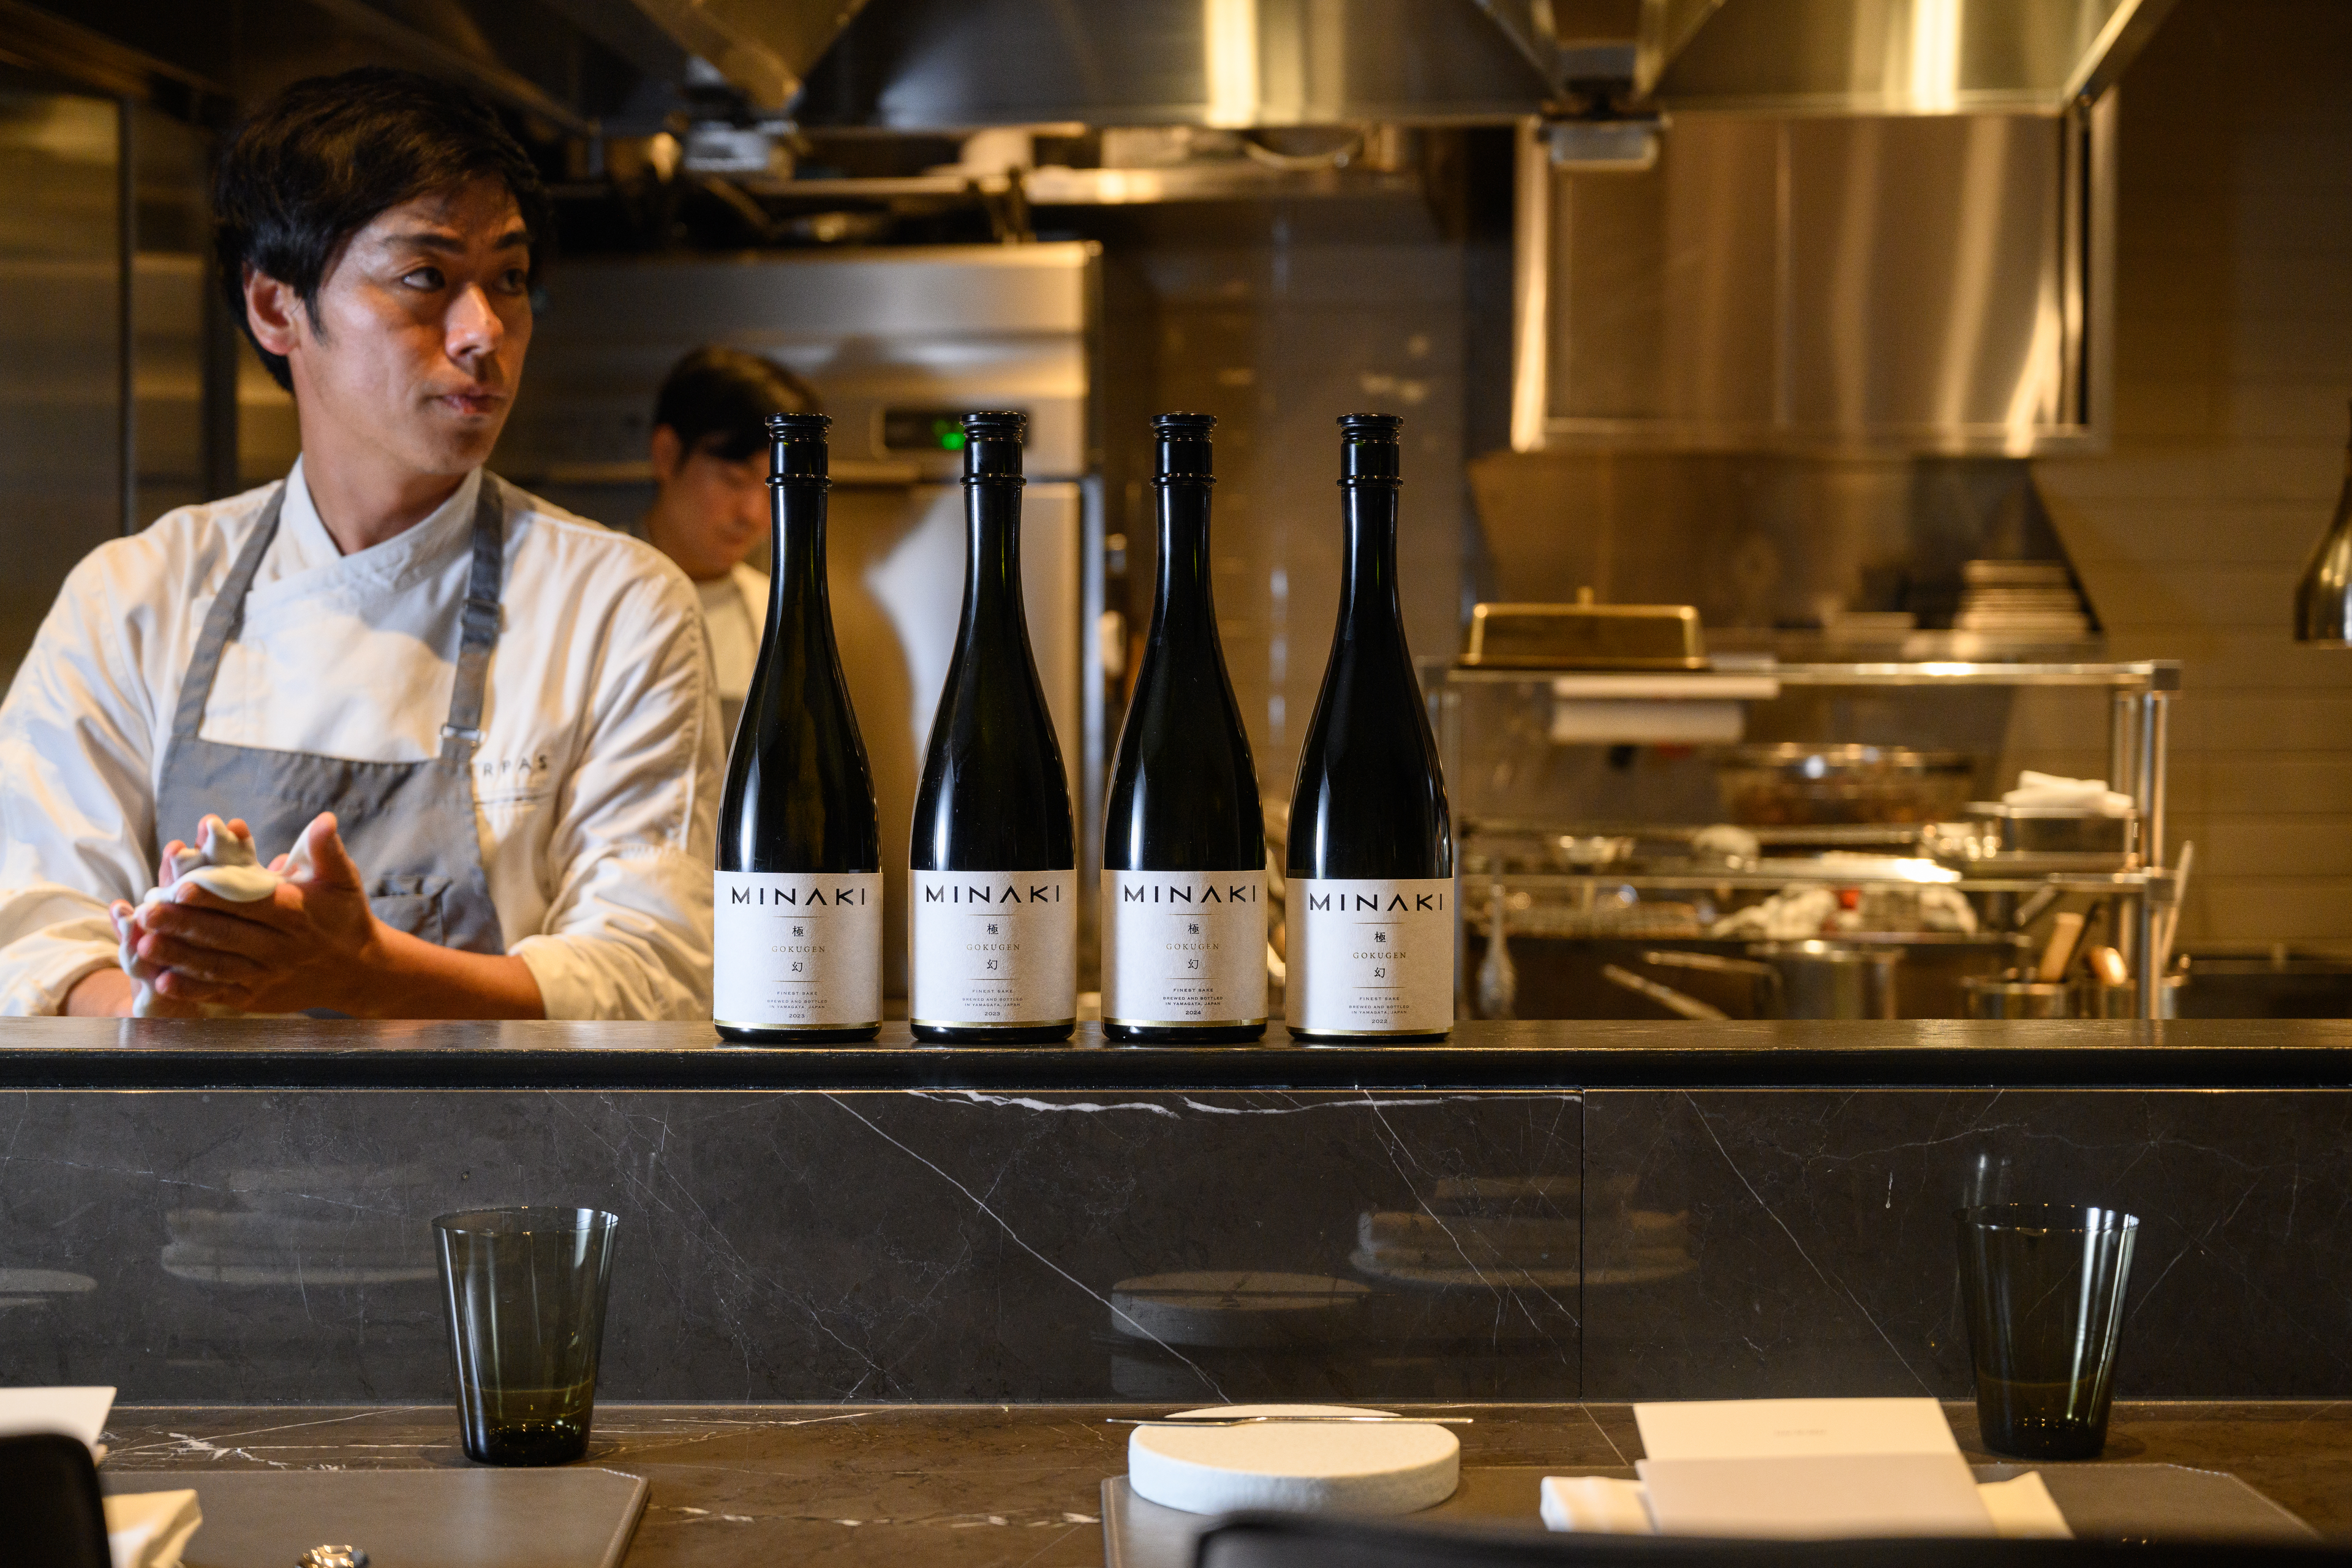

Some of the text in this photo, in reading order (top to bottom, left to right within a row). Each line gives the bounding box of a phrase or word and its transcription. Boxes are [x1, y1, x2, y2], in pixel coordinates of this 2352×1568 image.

[732, 886, 865, 906] MINAKI
[926, 884, 1060, 903] MINAKI
[1125, 884, 1256, 903] MINAKI
[1310, 893, 1442, 911] MINAKI
[792, 925, 804, 937] 極
[987, 923, 999, 935] 極
[1188, 923, 1199, 935] 極
[1374, 932, 1386, 943] 極
[791, 962, 803, 973] 幻
[987, 959, 998, 970] 幻
[1188, 959, 1199, 970] 幻
[1374, 967, 1385, 978] 幻
